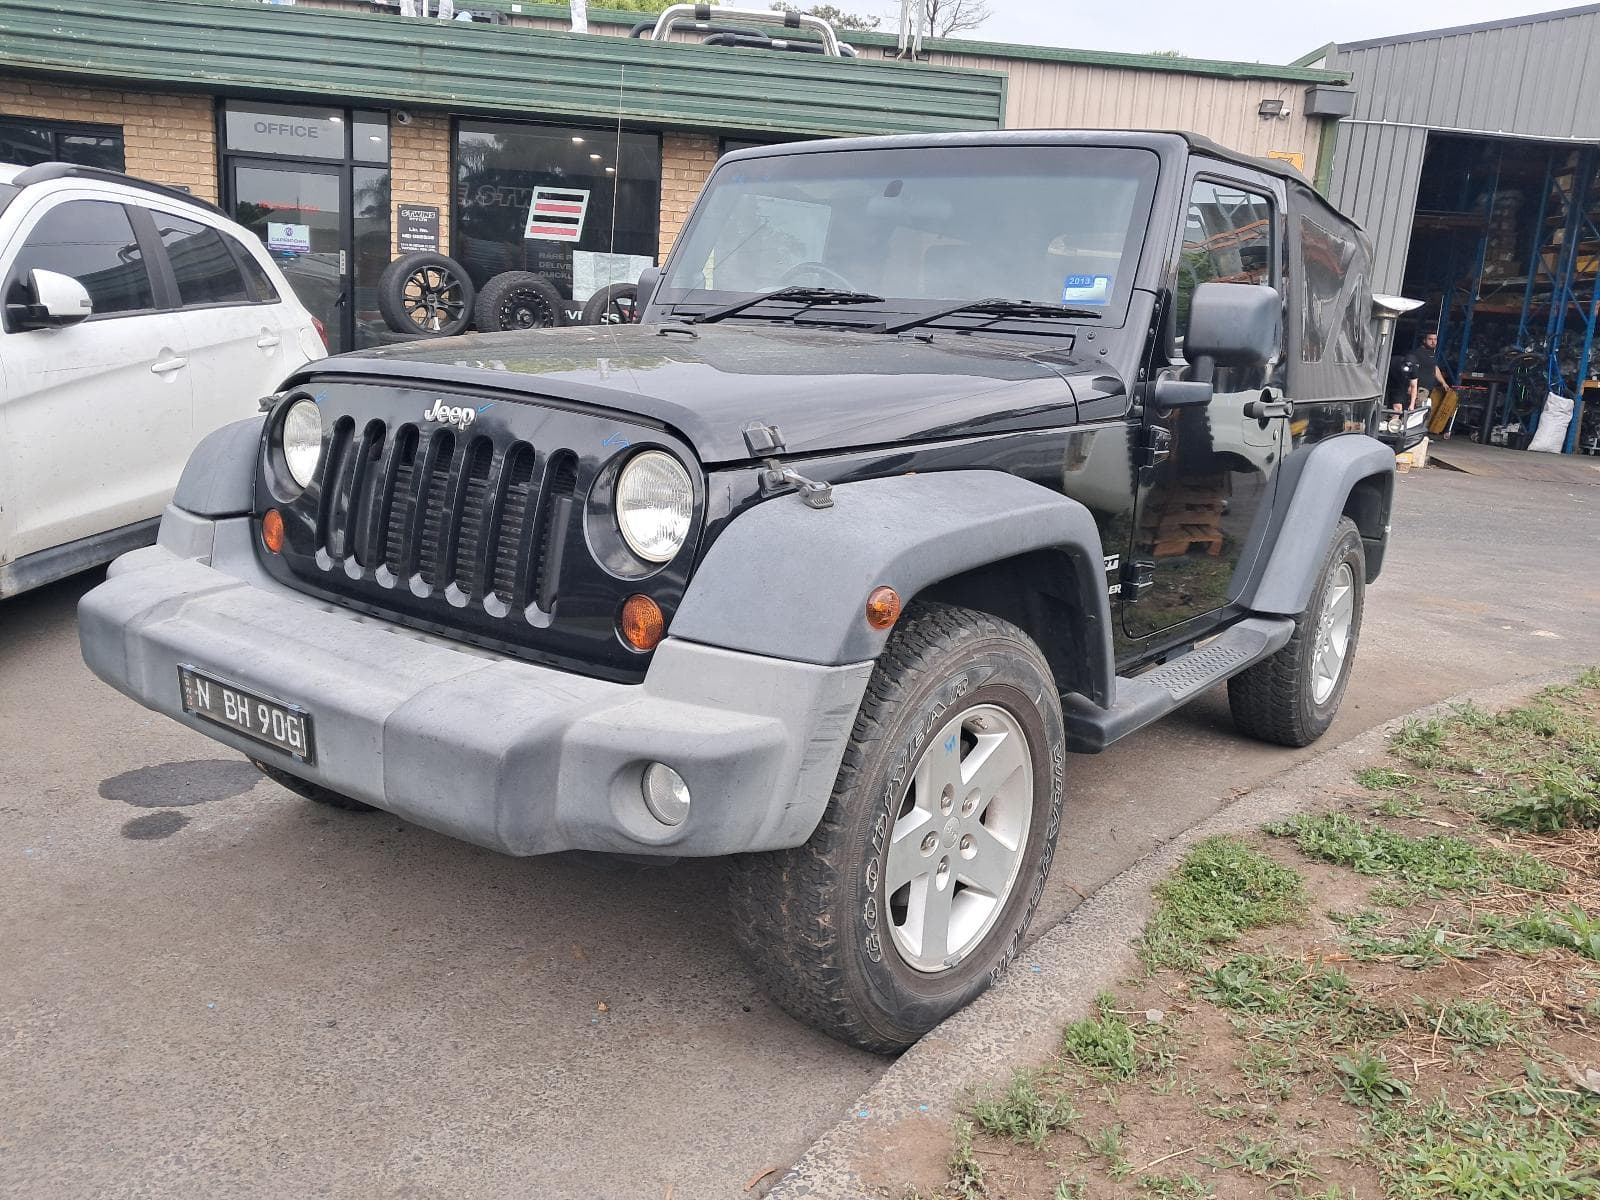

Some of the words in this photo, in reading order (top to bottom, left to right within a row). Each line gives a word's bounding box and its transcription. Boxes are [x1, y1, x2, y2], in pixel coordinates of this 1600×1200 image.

[254, 121, 319, 138] OFFICE
[538, 261, 573, 270] DELIVE
[538, 270, 573, 280] QUICKL
[1069, 277, 1091, 285] 2013
[424, 398, 476, 431] Jeep
[223, 688, 250, 728] BH
[257, 704, 301, 748] 90G
[863, 674, 969, 963] GOODYEAR
